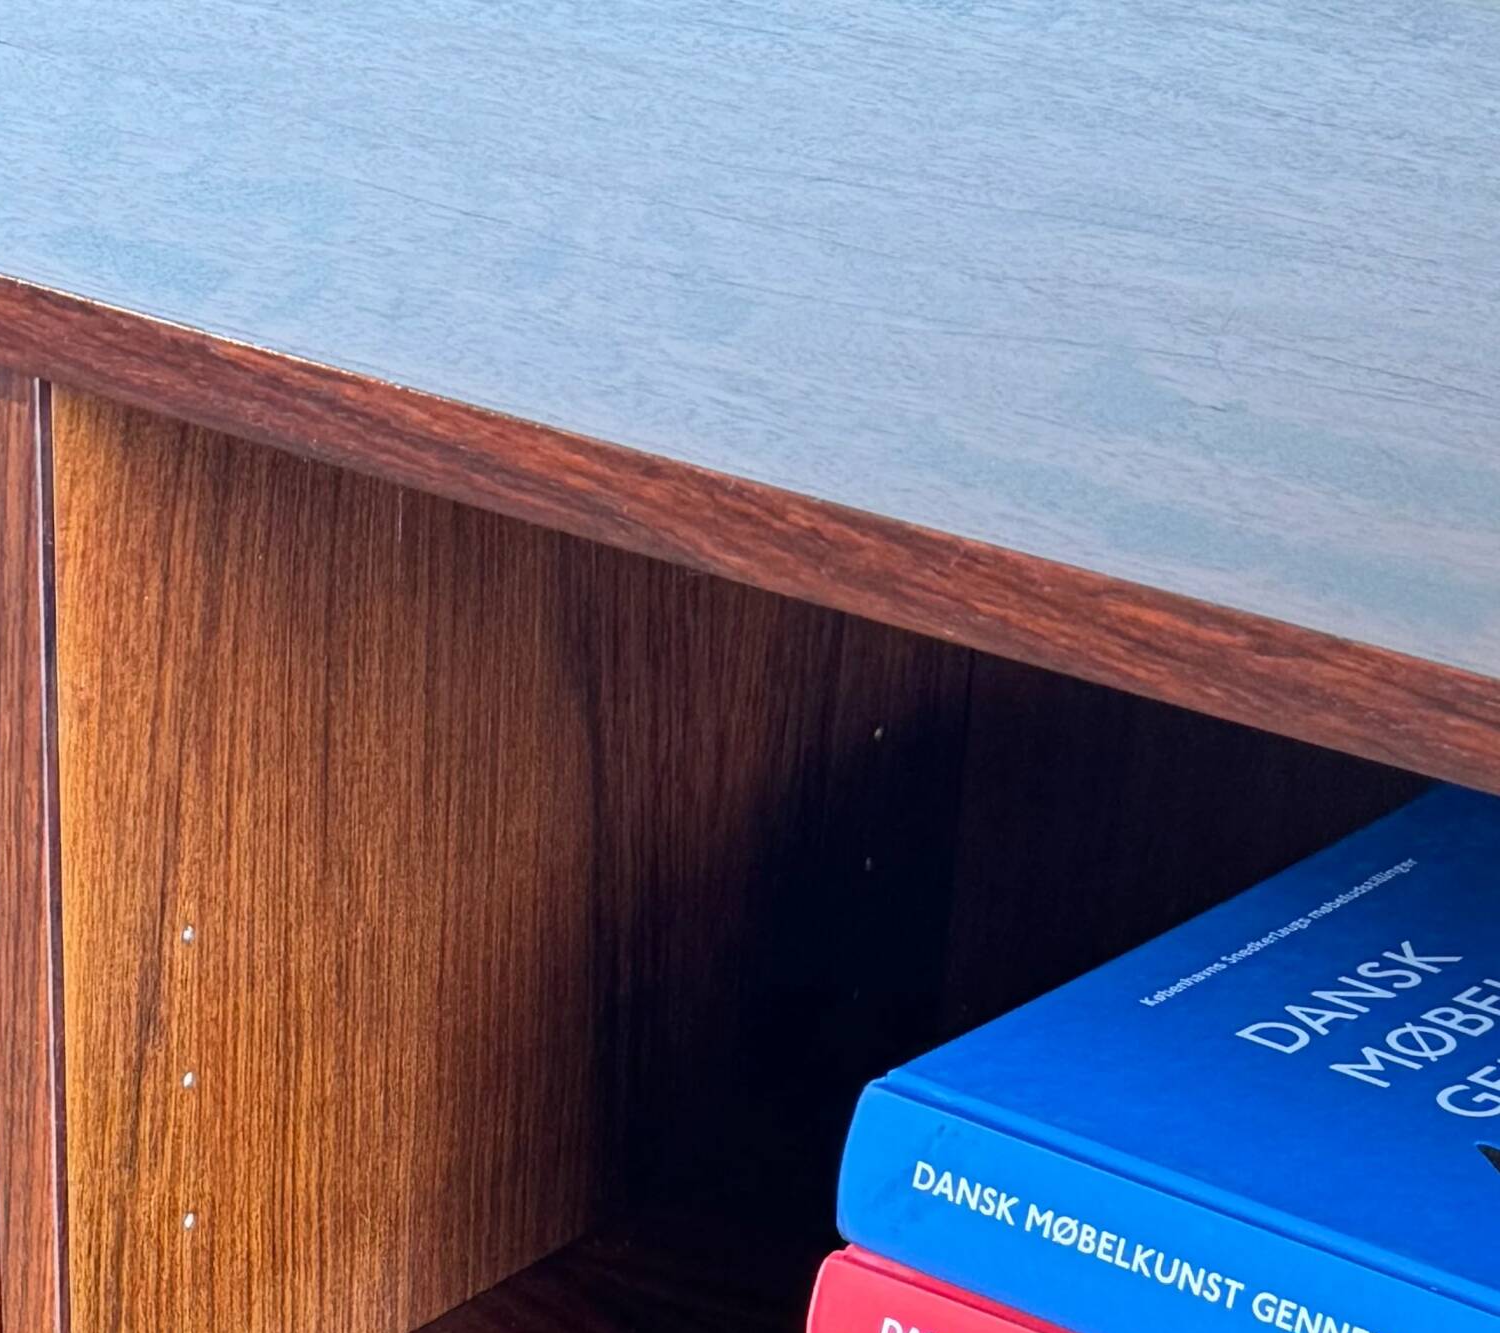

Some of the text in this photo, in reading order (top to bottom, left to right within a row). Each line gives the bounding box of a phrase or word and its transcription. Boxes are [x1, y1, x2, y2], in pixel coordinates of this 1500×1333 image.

[1140, 961, 1227, 1006] Københavns
[1235, 940, 1463, 1054] DANSK
[1436, 1058, 1500, 1118] GE
[912, 1161, 1020, 1226] DANSK
[1025, 1203, 1245, 1309] MØBELKUNST
